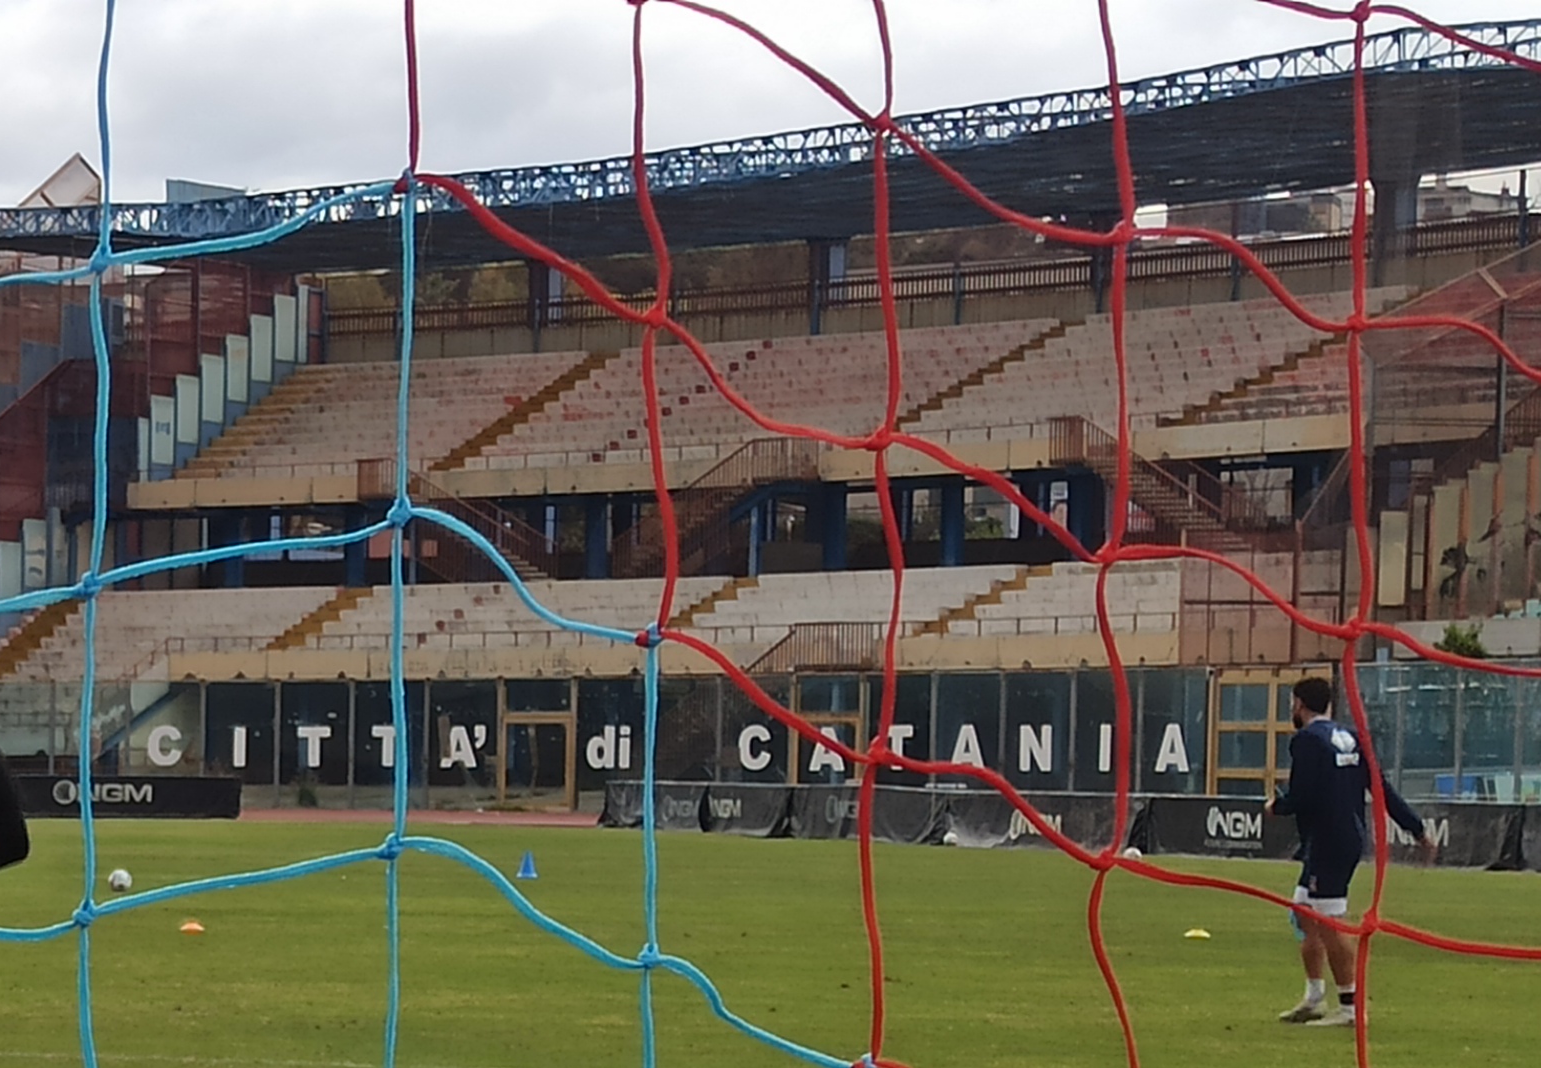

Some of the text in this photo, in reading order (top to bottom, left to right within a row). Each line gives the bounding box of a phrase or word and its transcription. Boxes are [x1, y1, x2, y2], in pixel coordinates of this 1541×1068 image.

[586, 726, 631, 769] di
[738, 724, 1190, 772] CATANIA
[1216, 811, 1262, 839] NGM
